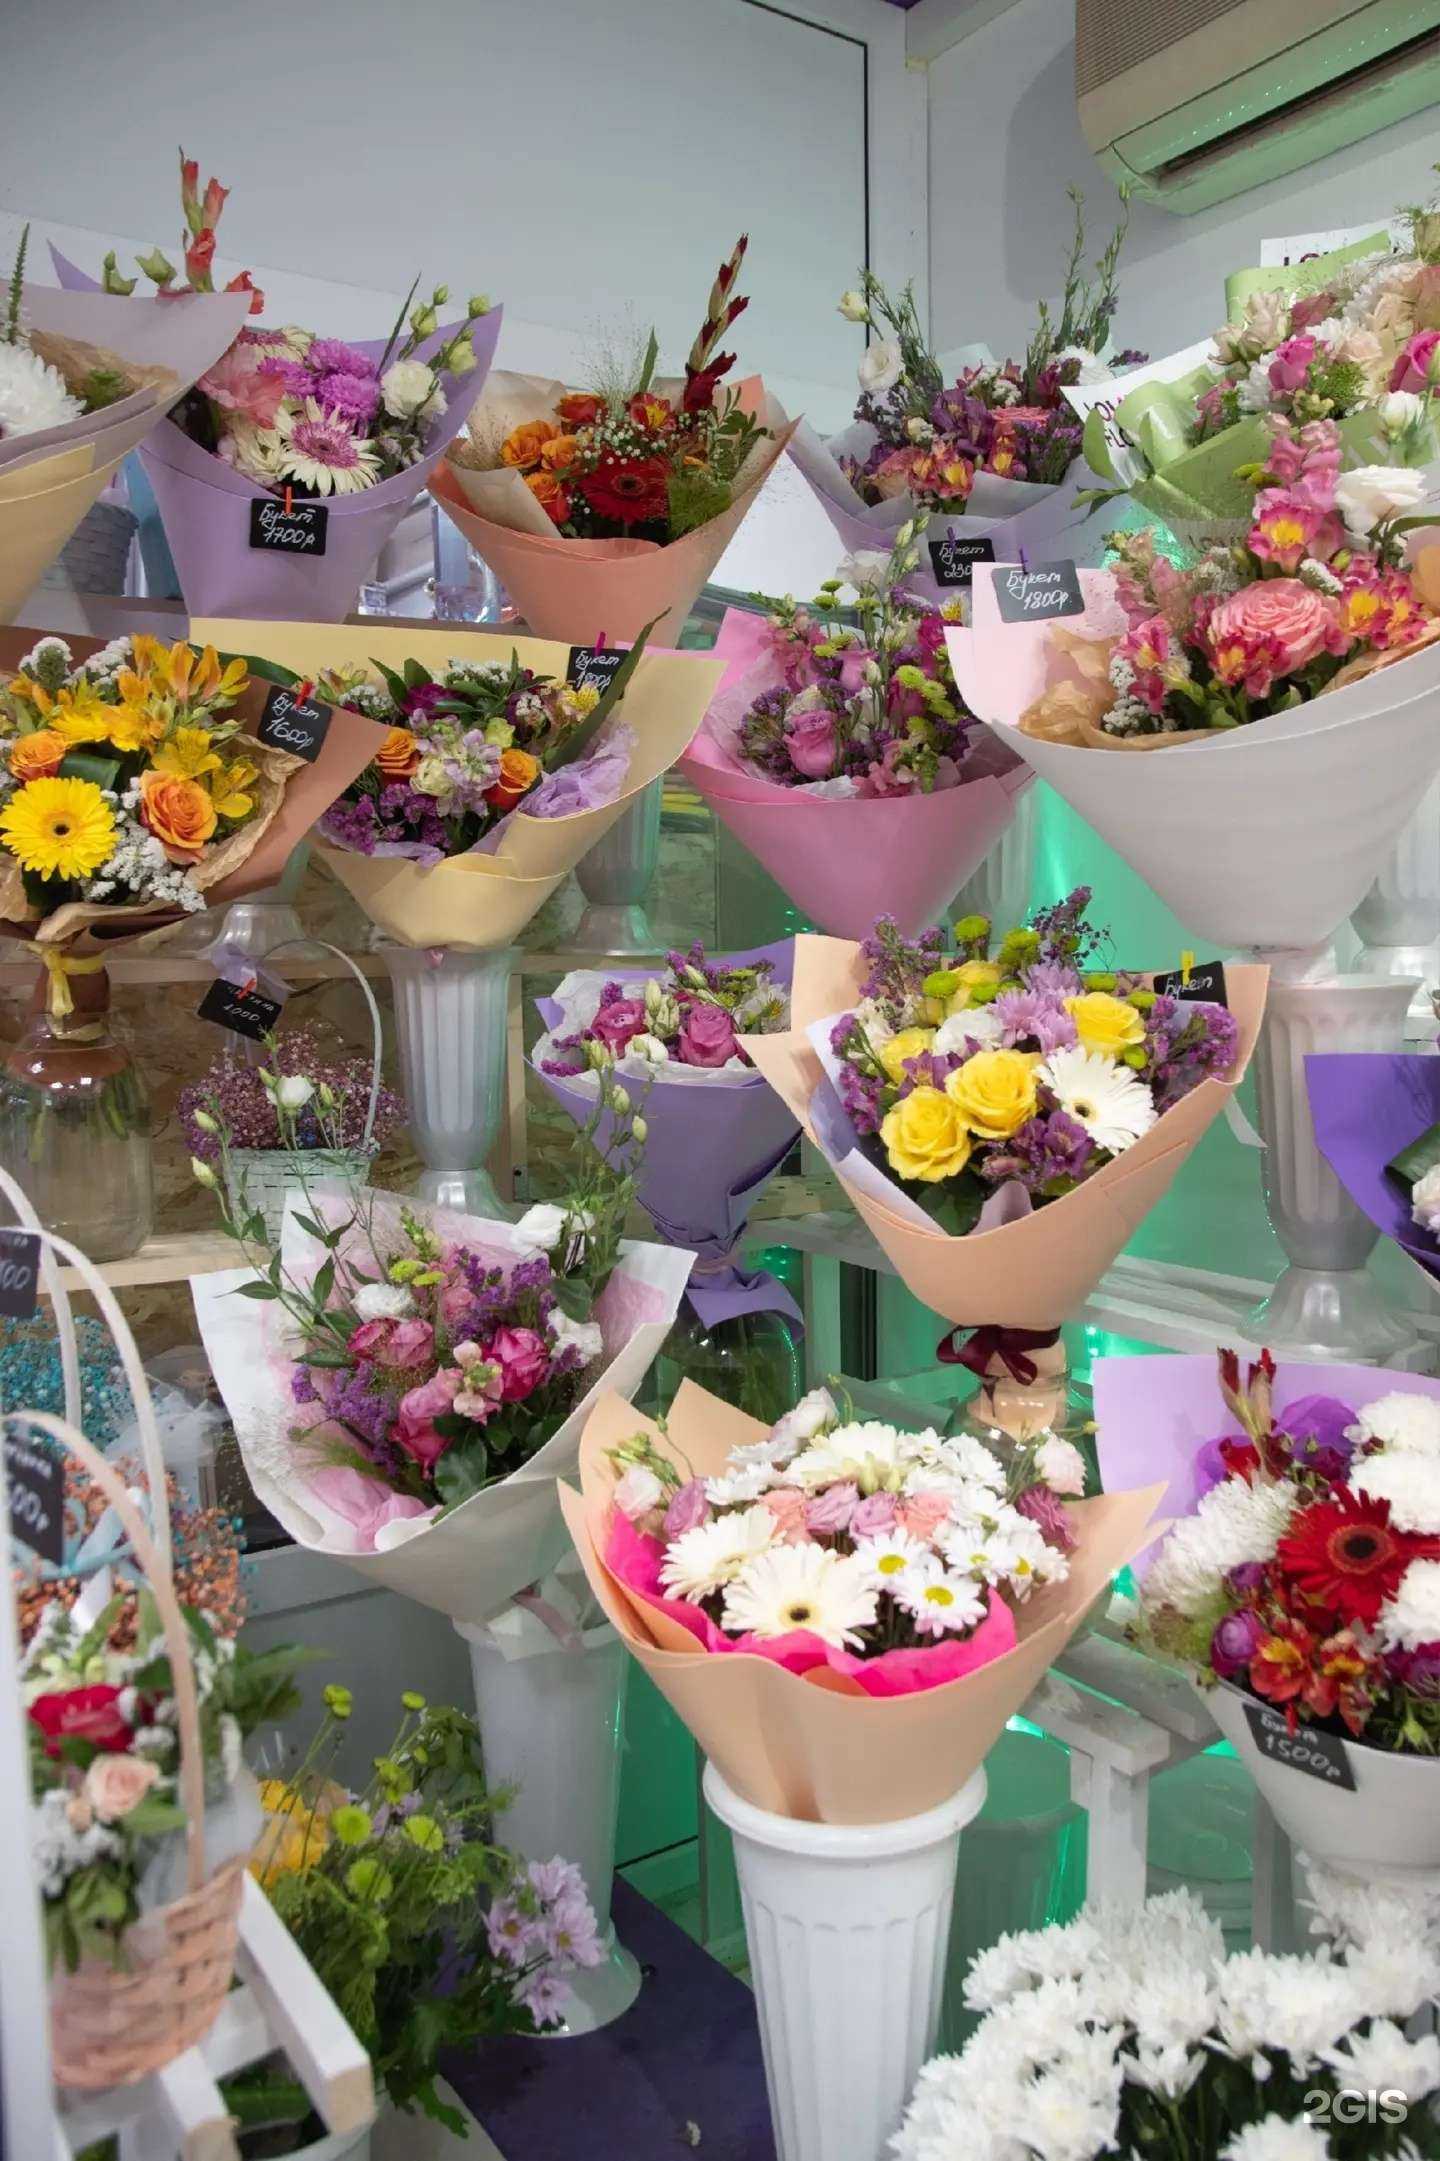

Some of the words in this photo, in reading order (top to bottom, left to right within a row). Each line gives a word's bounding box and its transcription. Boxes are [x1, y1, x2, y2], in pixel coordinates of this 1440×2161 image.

[259, 503, 316, 530] Букет
[943, 563, 972, 578] 230
[1006, 570, 1060, 600] Букет
[575, 650, 620, 671] Букет
[272, 692, 320, 720] Букет
